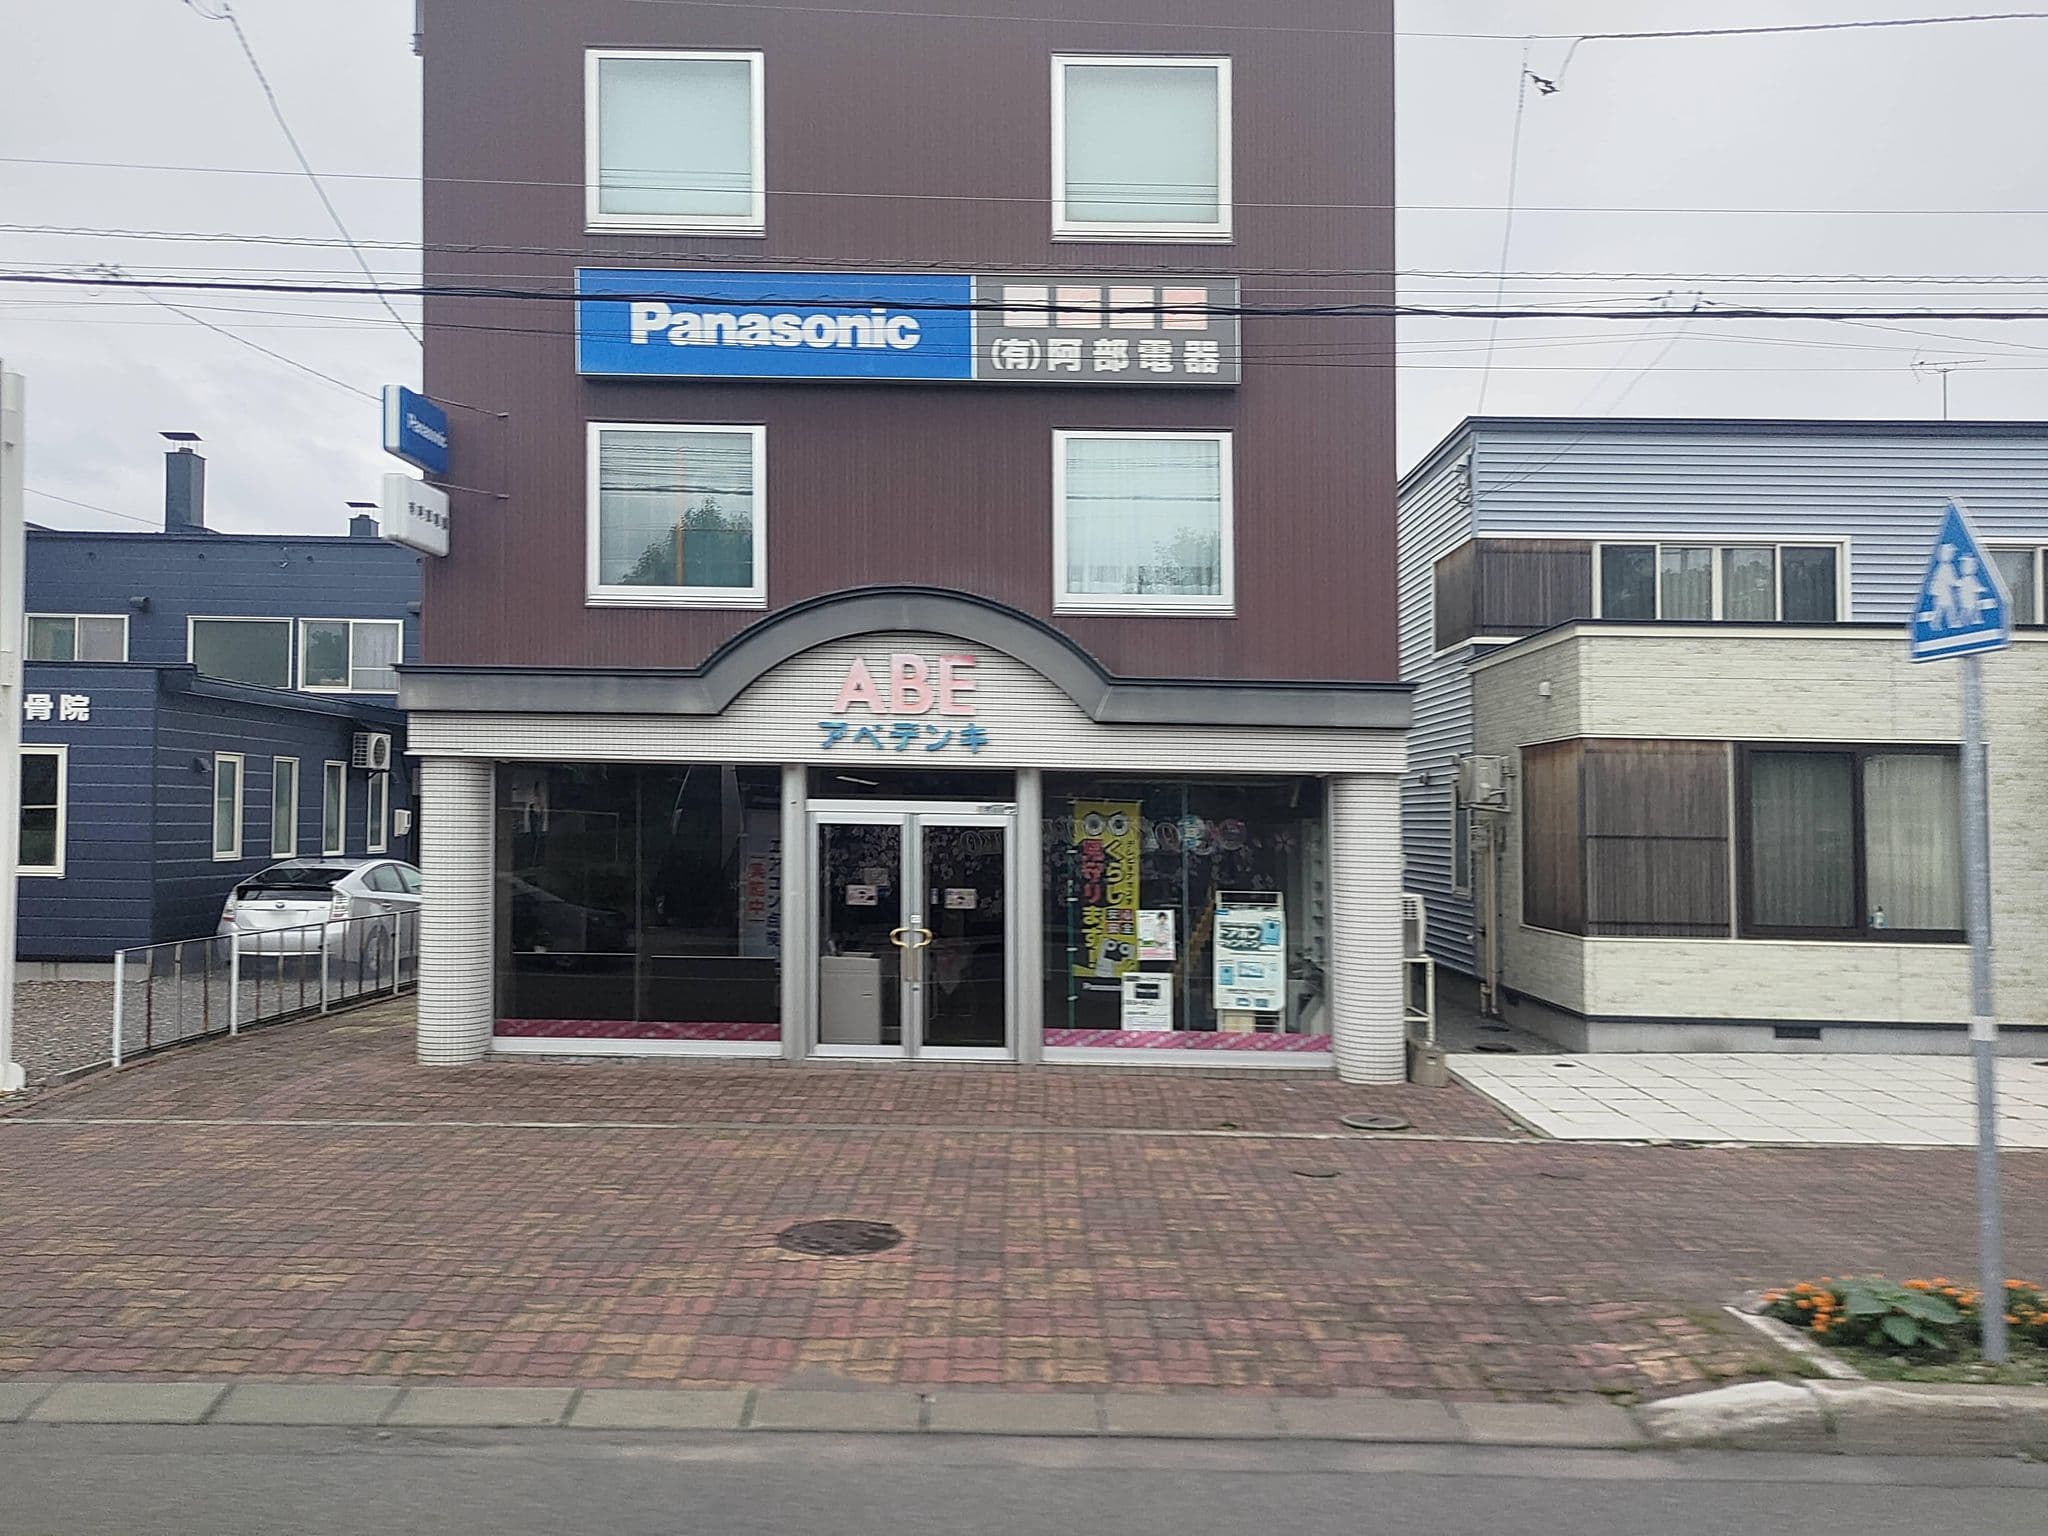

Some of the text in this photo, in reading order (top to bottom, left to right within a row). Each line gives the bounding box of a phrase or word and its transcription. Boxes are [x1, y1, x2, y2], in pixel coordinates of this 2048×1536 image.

[629, 301, 920, 349] Panasonic
[991, 338, 1221, 373] (有)阿部電器
[832, 654, 976, 716] ABE
[23, 693, 91, 721] 骨院
